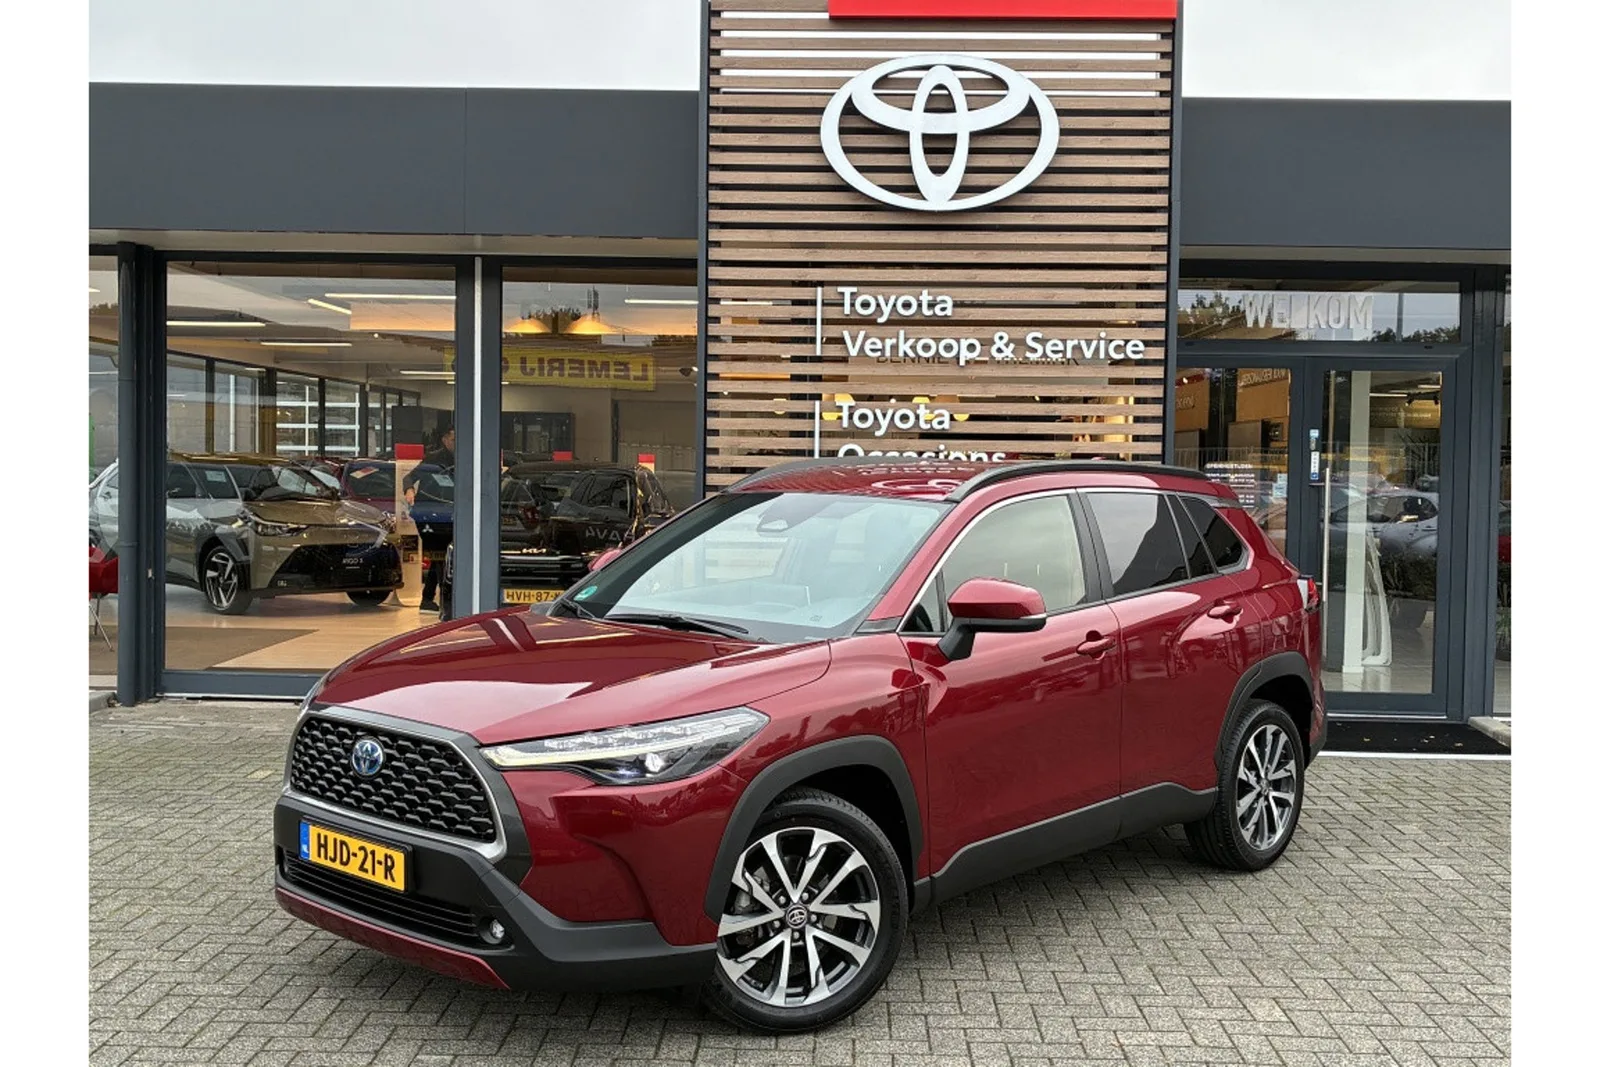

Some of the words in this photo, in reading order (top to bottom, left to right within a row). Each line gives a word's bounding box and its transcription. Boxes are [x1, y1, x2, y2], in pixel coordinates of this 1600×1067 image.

[837, 286, 954, 323] Toyota
[1243, 293, 1373, 329] WELKOM
[842, 330, 981, 366] Verkoop
[990, 332, 1015, 359] &
[1025, 332, 1145, 360] Service
[834, 401, 951, 437] Toyota
[316, 832, 396, 883] HJD-21-R
